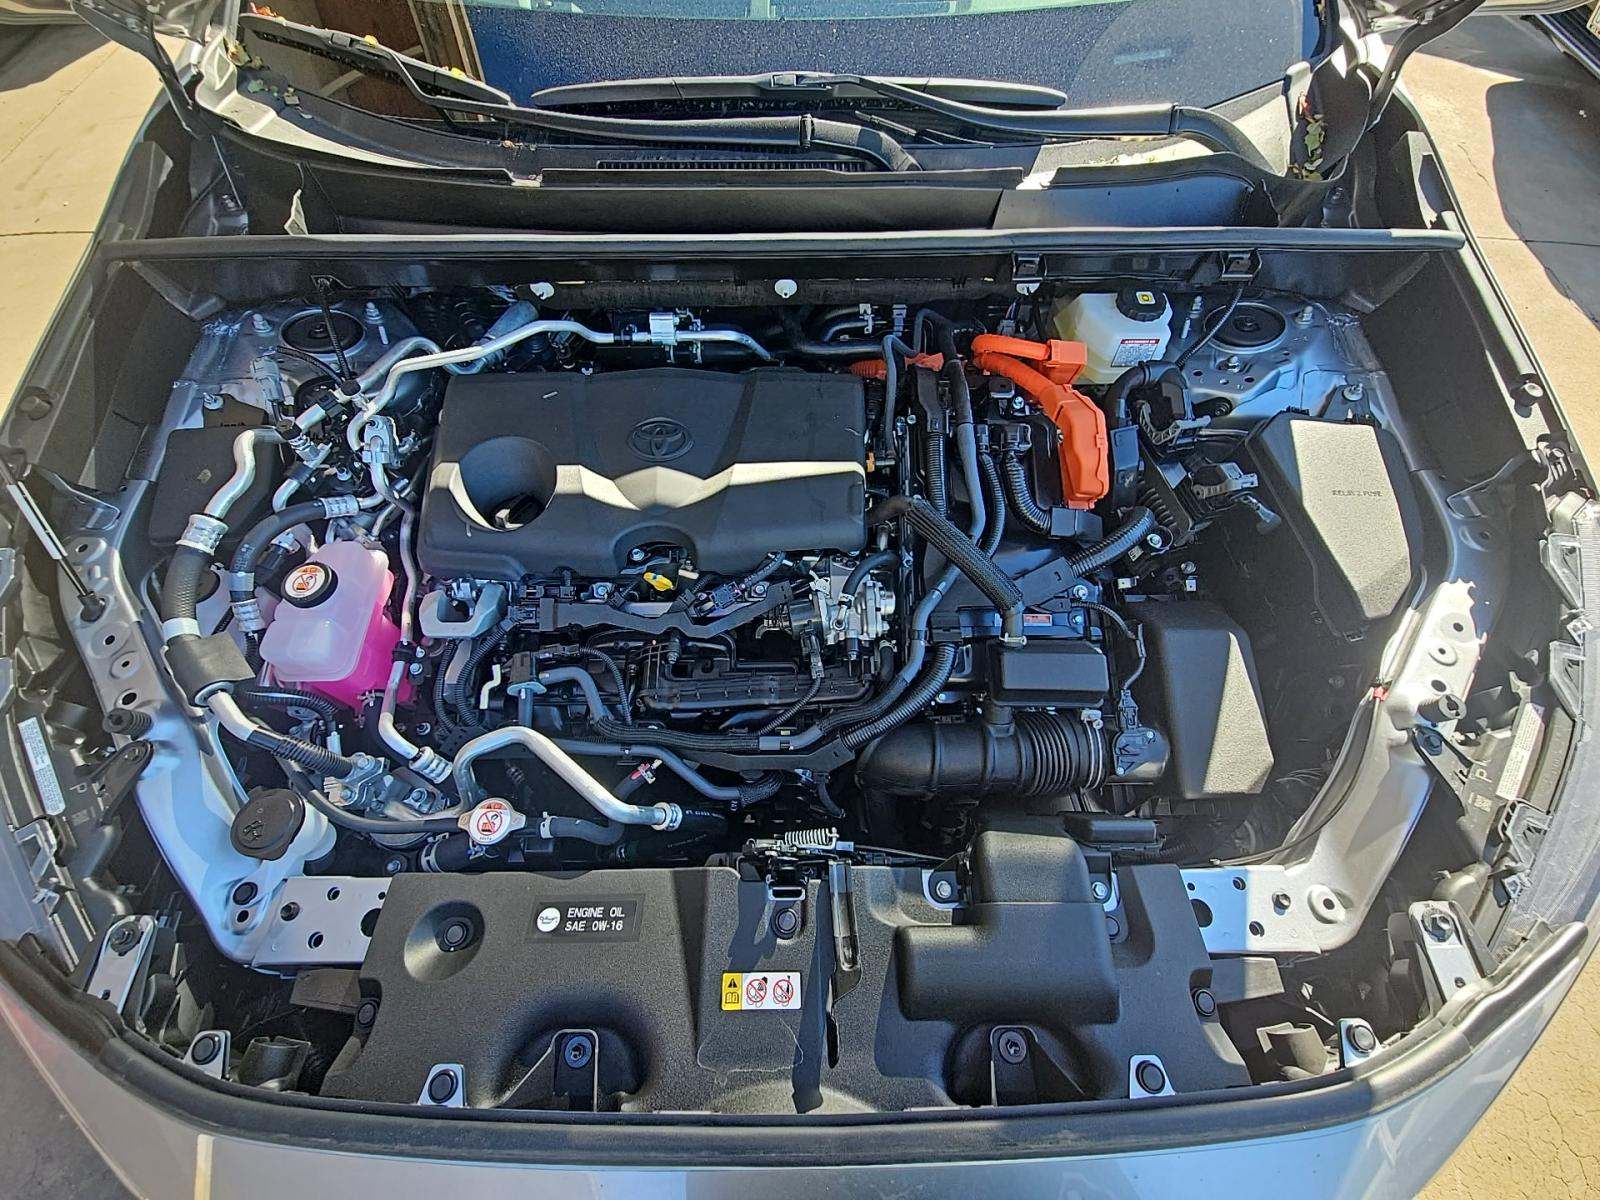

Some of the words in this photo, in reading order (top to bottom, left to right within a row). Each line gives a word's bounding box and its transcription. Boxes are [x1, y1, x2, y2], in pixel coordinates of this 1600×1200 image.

[567, 907, 604, 918] ENGINE
[609, 906, 625, 918] OIL
[564, 920, 587, 932] SAE
[591, 920, 623, 932] 0W-16
